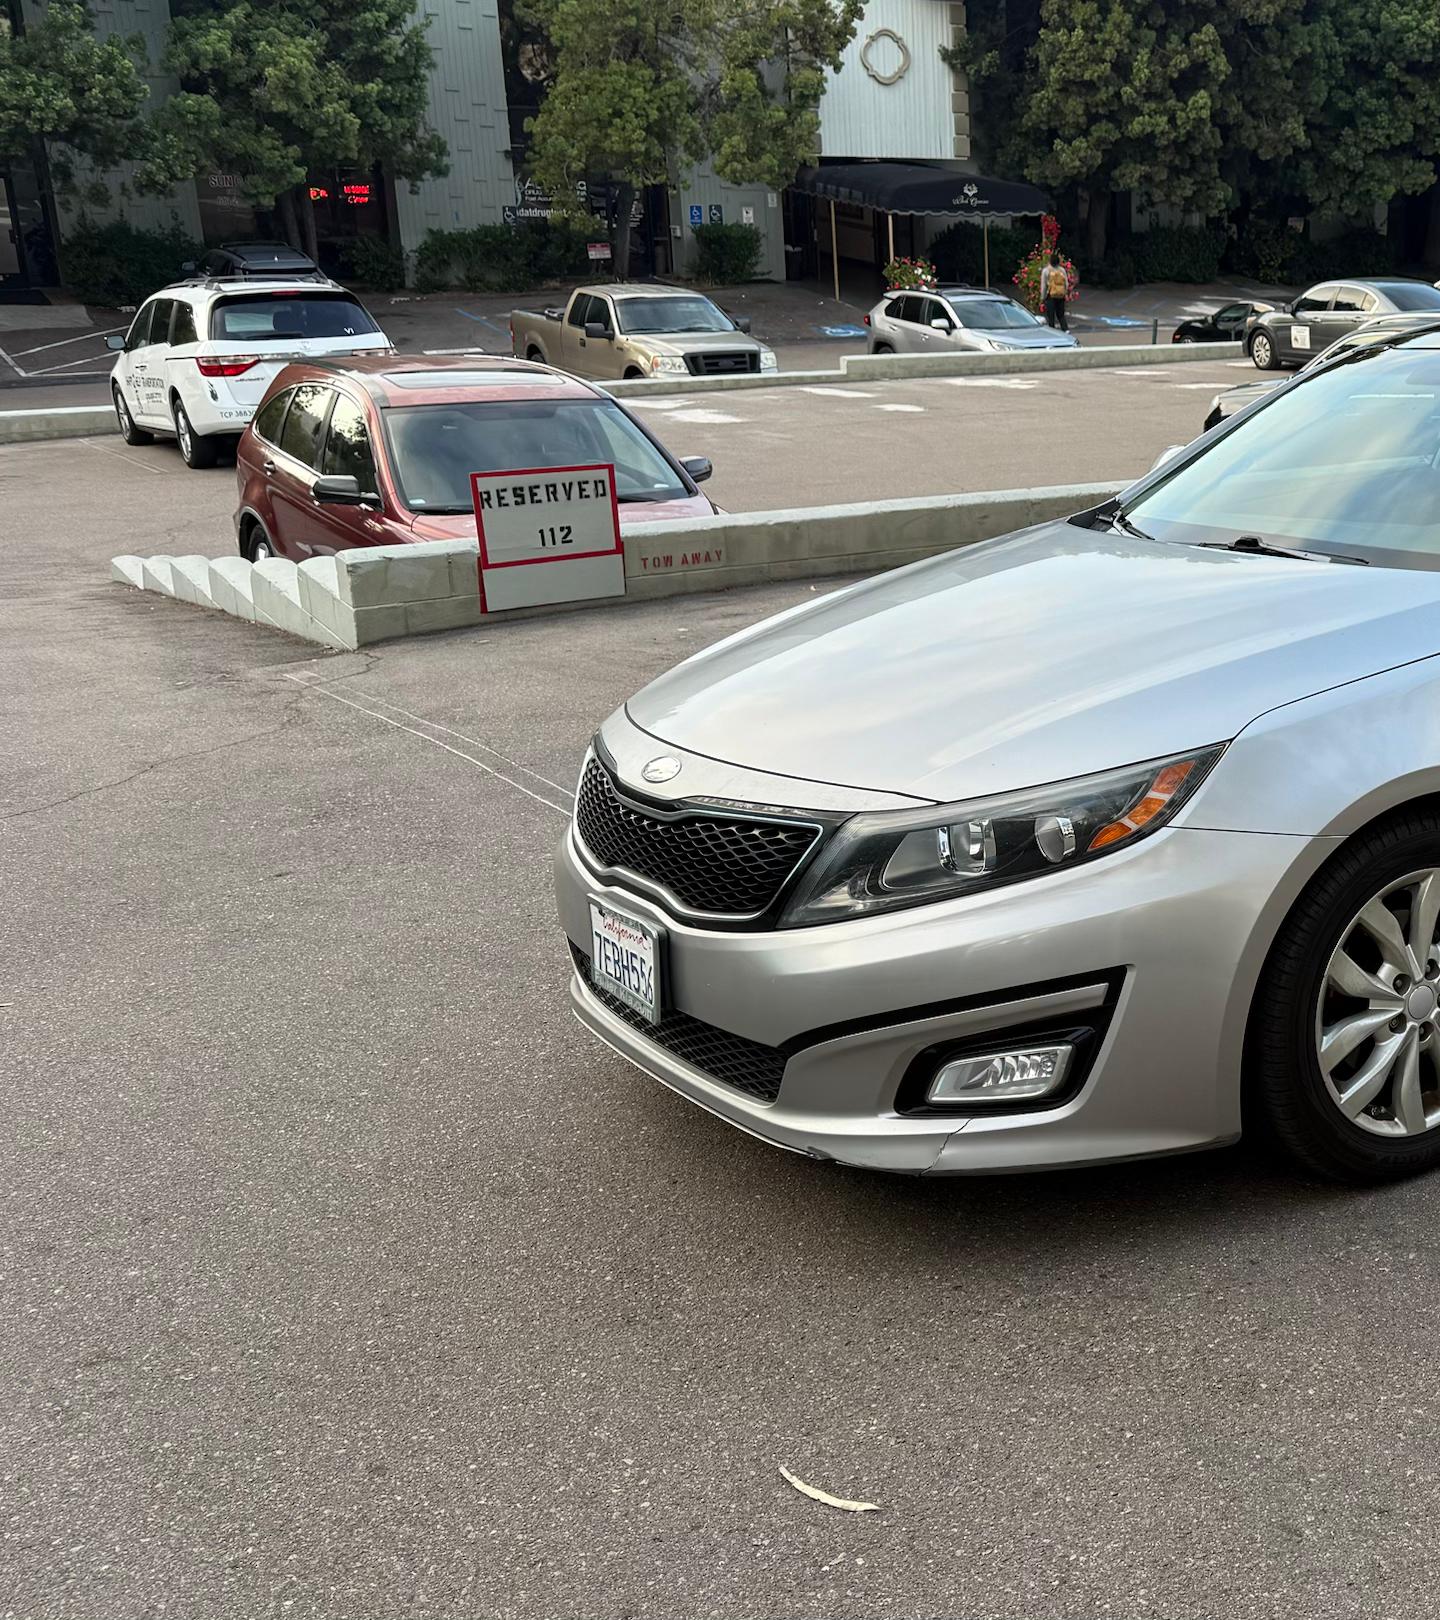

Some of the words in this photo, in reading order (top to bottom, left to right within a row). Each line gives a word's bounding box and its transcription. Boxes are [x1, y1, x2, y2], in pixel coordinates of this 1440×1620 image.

[480, 479, 607, 509] RESERVED
[538, 525, 573, 547] 112
[641, 555, 673, 570] TOW
[681, 550, 723, 566] AWAY
[603, 918, 648, 951] California
[594, 931, 653, 1005] 7EBH556
